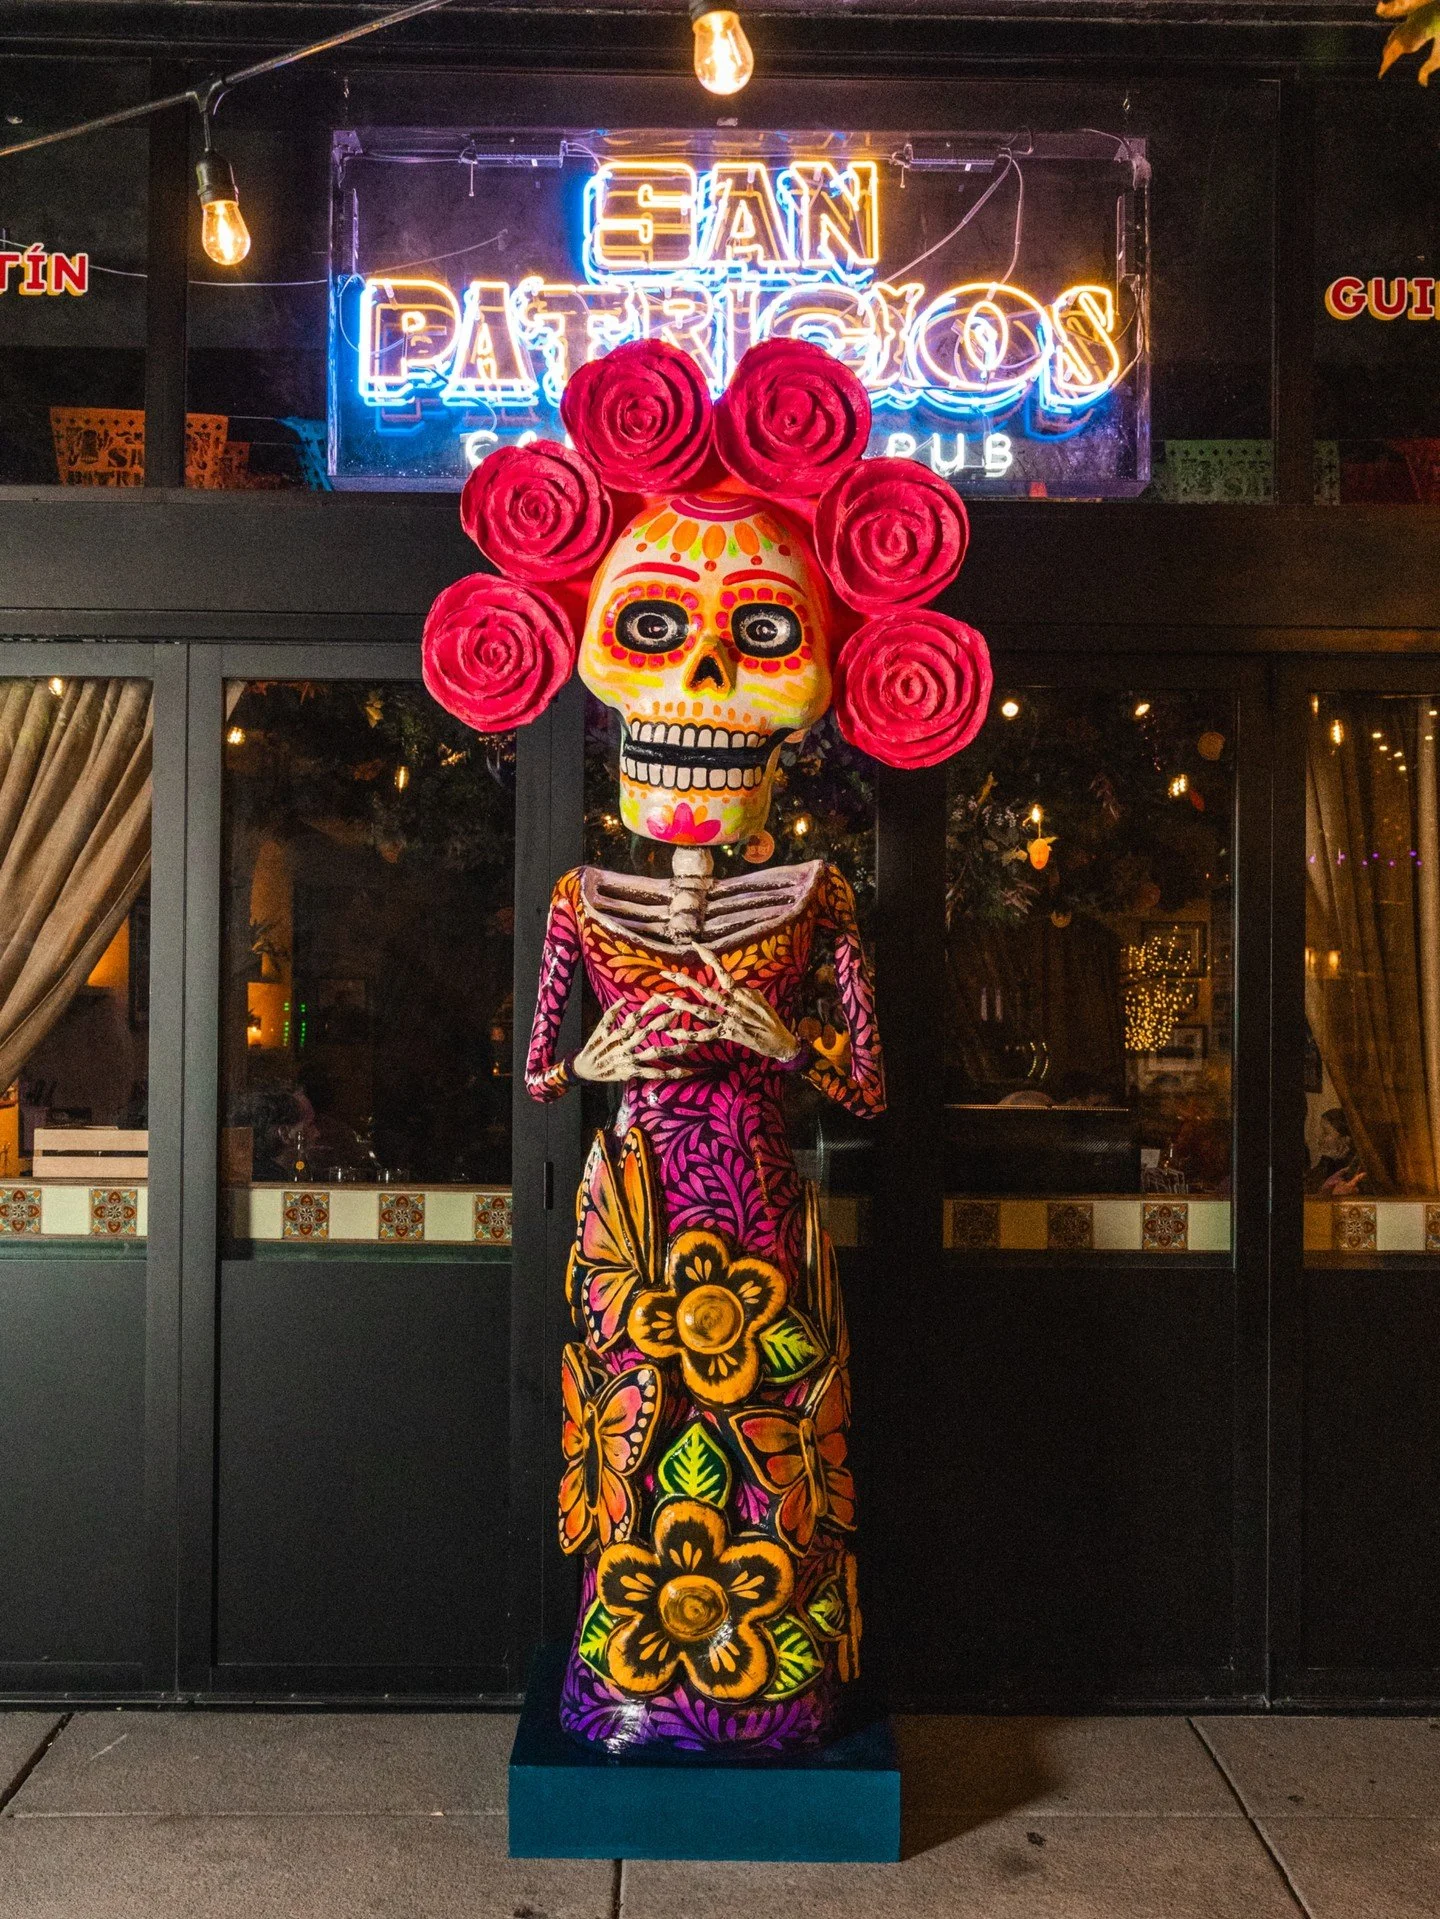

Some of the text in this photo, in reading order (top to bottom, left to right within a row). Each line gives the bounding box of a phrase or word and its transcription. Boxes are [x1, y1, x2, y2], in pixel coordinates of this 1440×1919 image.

[585, 160, 878, 280] SAN
[1325, 276, 1440, 320] GUI
[886, 432, 1013, 473] PUB
